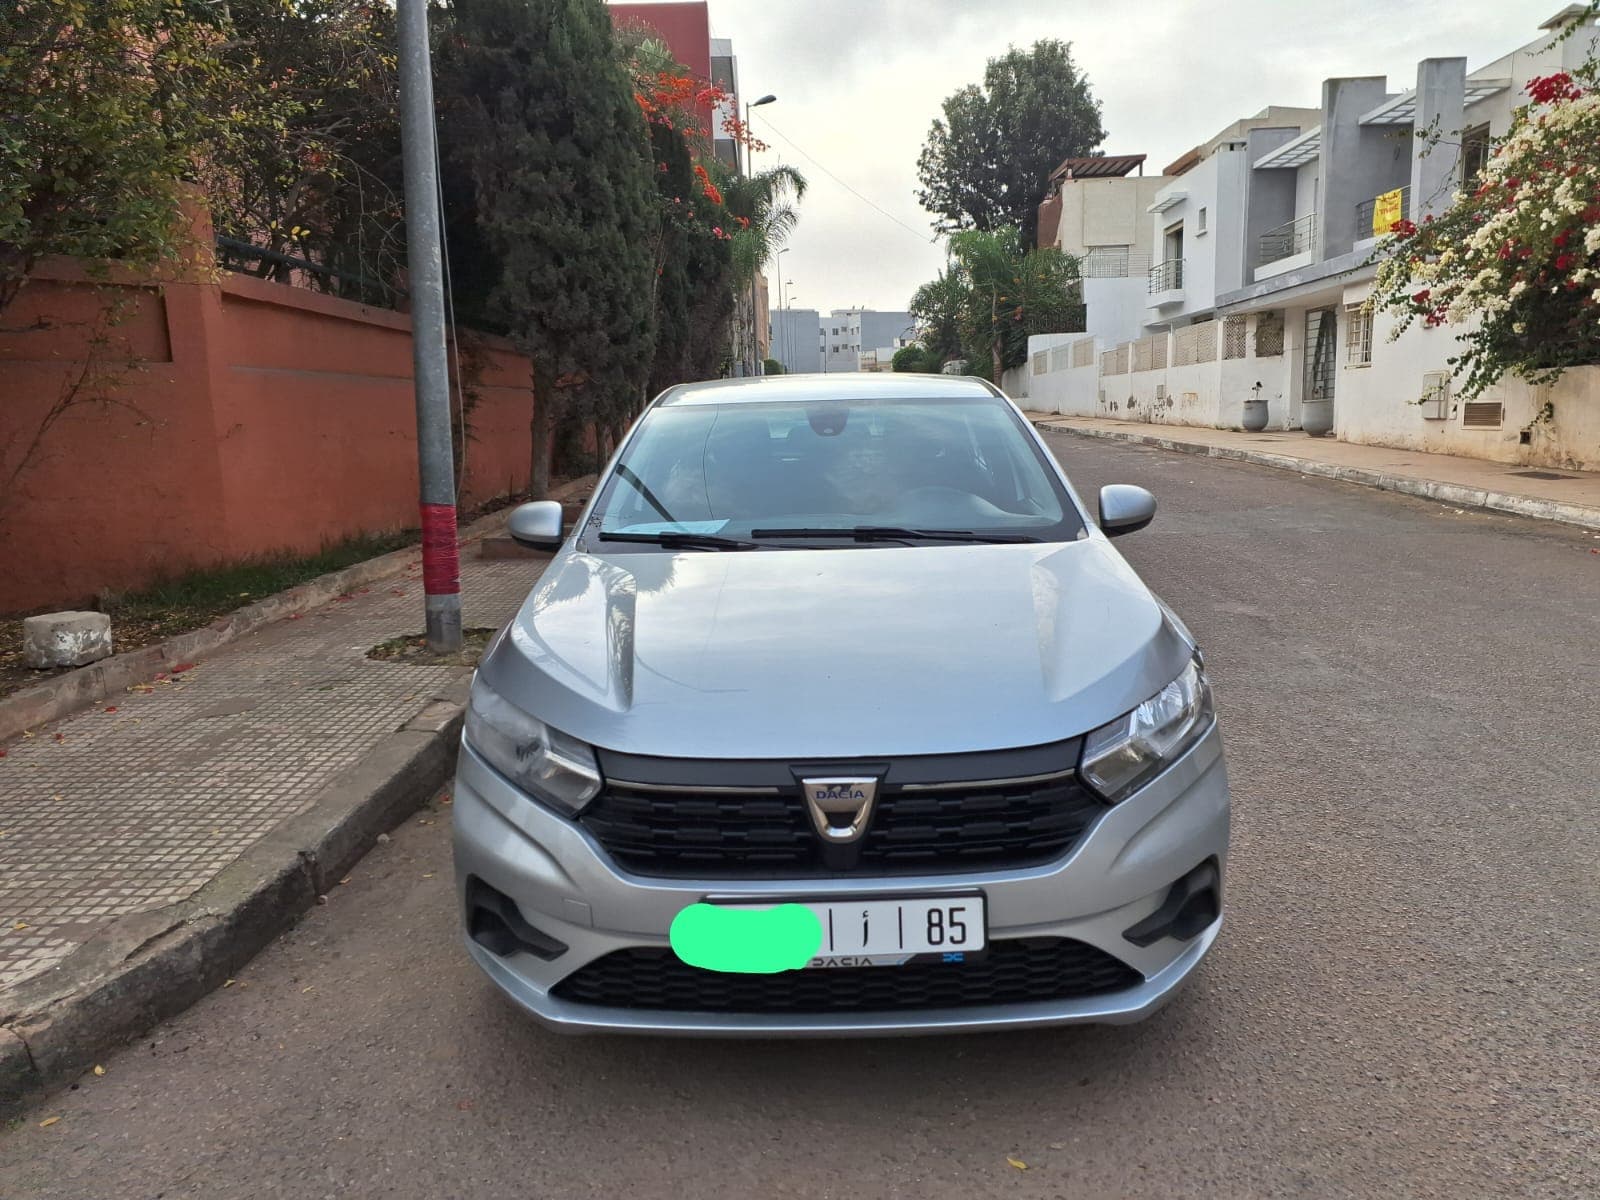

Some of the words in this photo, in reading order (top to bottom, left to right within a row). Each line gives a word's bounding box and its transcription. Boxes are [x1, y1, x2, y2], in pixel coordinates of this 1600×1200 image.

[816, 790, 865, 799] DACIA
[926, 907, 967, 946] 85
[811, 957, 873, 967] DACIA
